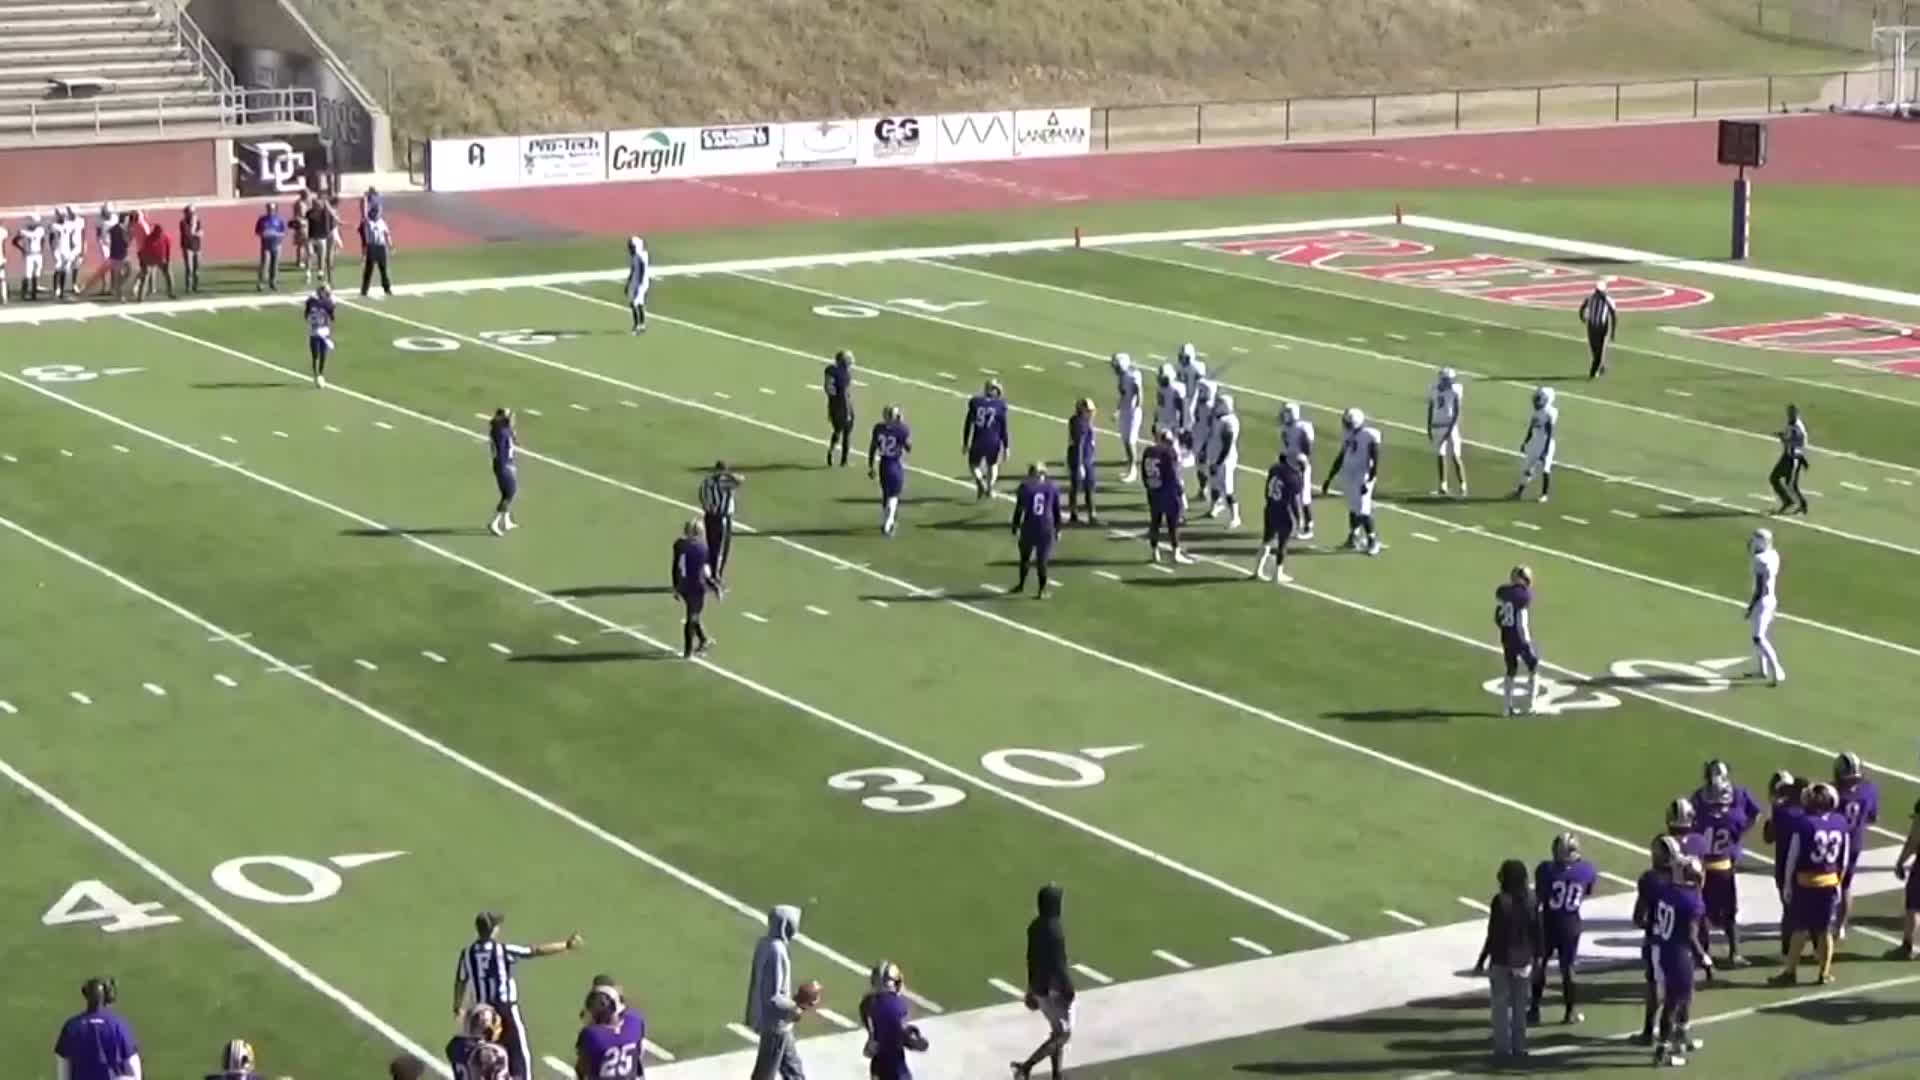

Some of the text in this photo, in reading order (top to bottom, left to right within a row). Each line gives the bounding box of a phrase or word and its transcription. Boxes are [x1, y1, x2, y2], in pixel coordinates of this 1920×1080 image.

[612, 141, 686, 174] Cargill
[1183, 231, 1714, 312] RED
[1033, 493, 1046, 515] 6
[827, 748, 1106, 812] 30
[1810, 829, 1842, 863] 33
[42, 855, 342, 933] 40
[1549, 880, 1583, 911] 30
[600, 1043, 637, 1077] 25
